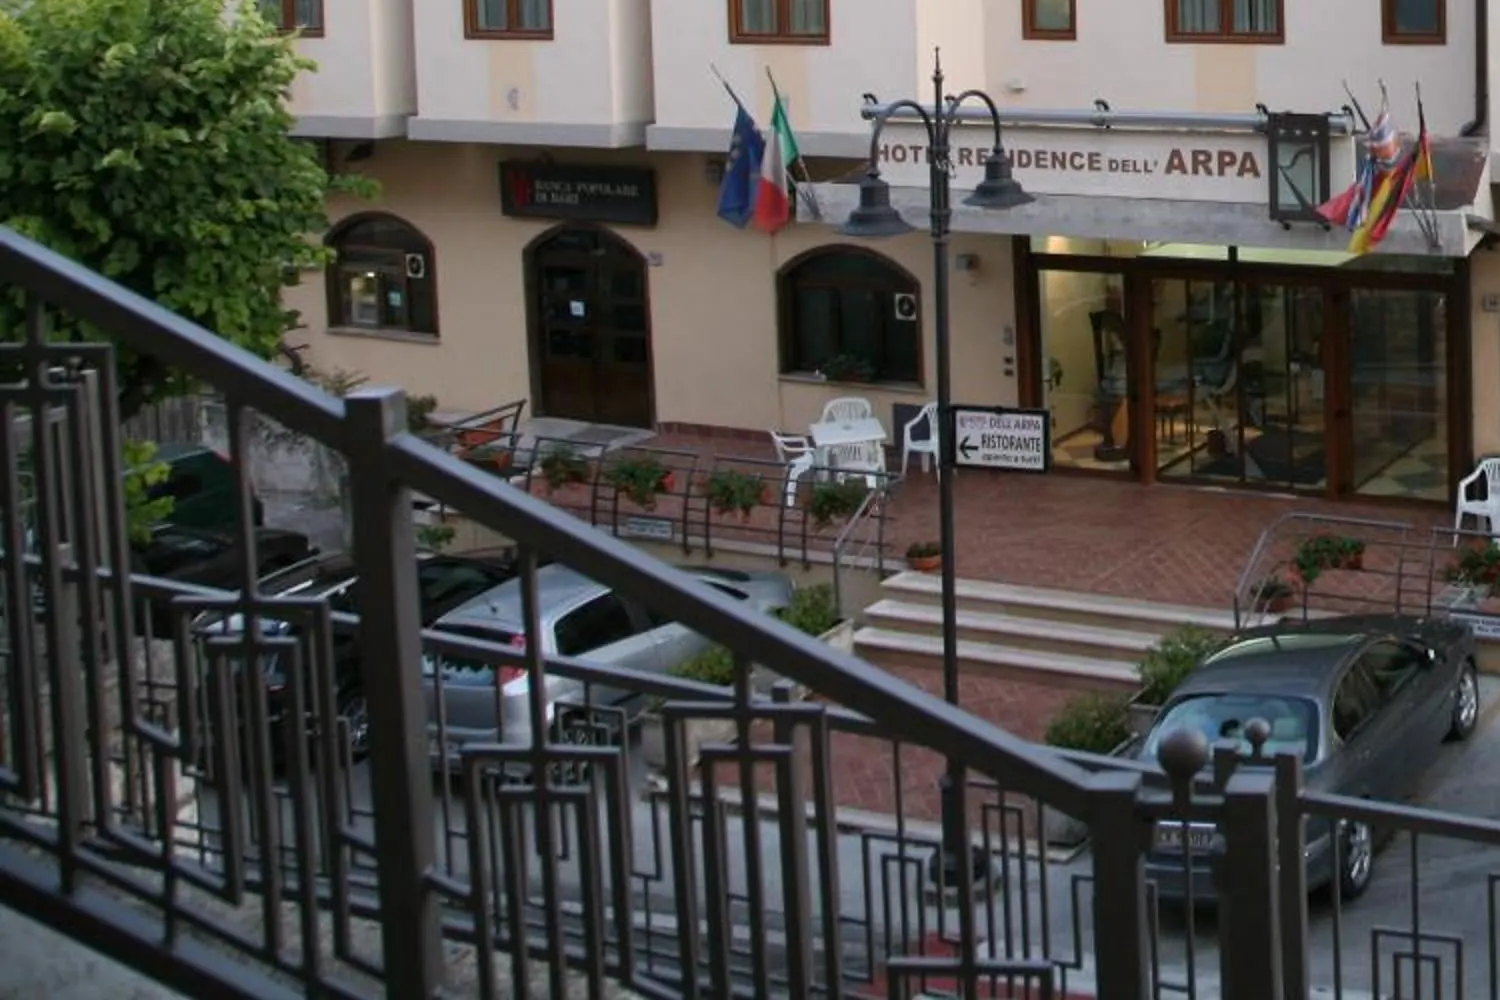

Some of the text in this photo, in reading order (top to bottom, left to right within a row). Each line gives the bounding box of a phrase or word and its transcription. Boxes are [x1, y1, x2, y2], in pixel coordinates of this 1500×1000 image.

[959, 146, 1102, 172] REIDENCE
[1108, 158, 1158, 173] DELL'
[1164, 148, 1261, 178] ARPA
[981, 433, 1041, 453] RISTORANTE
